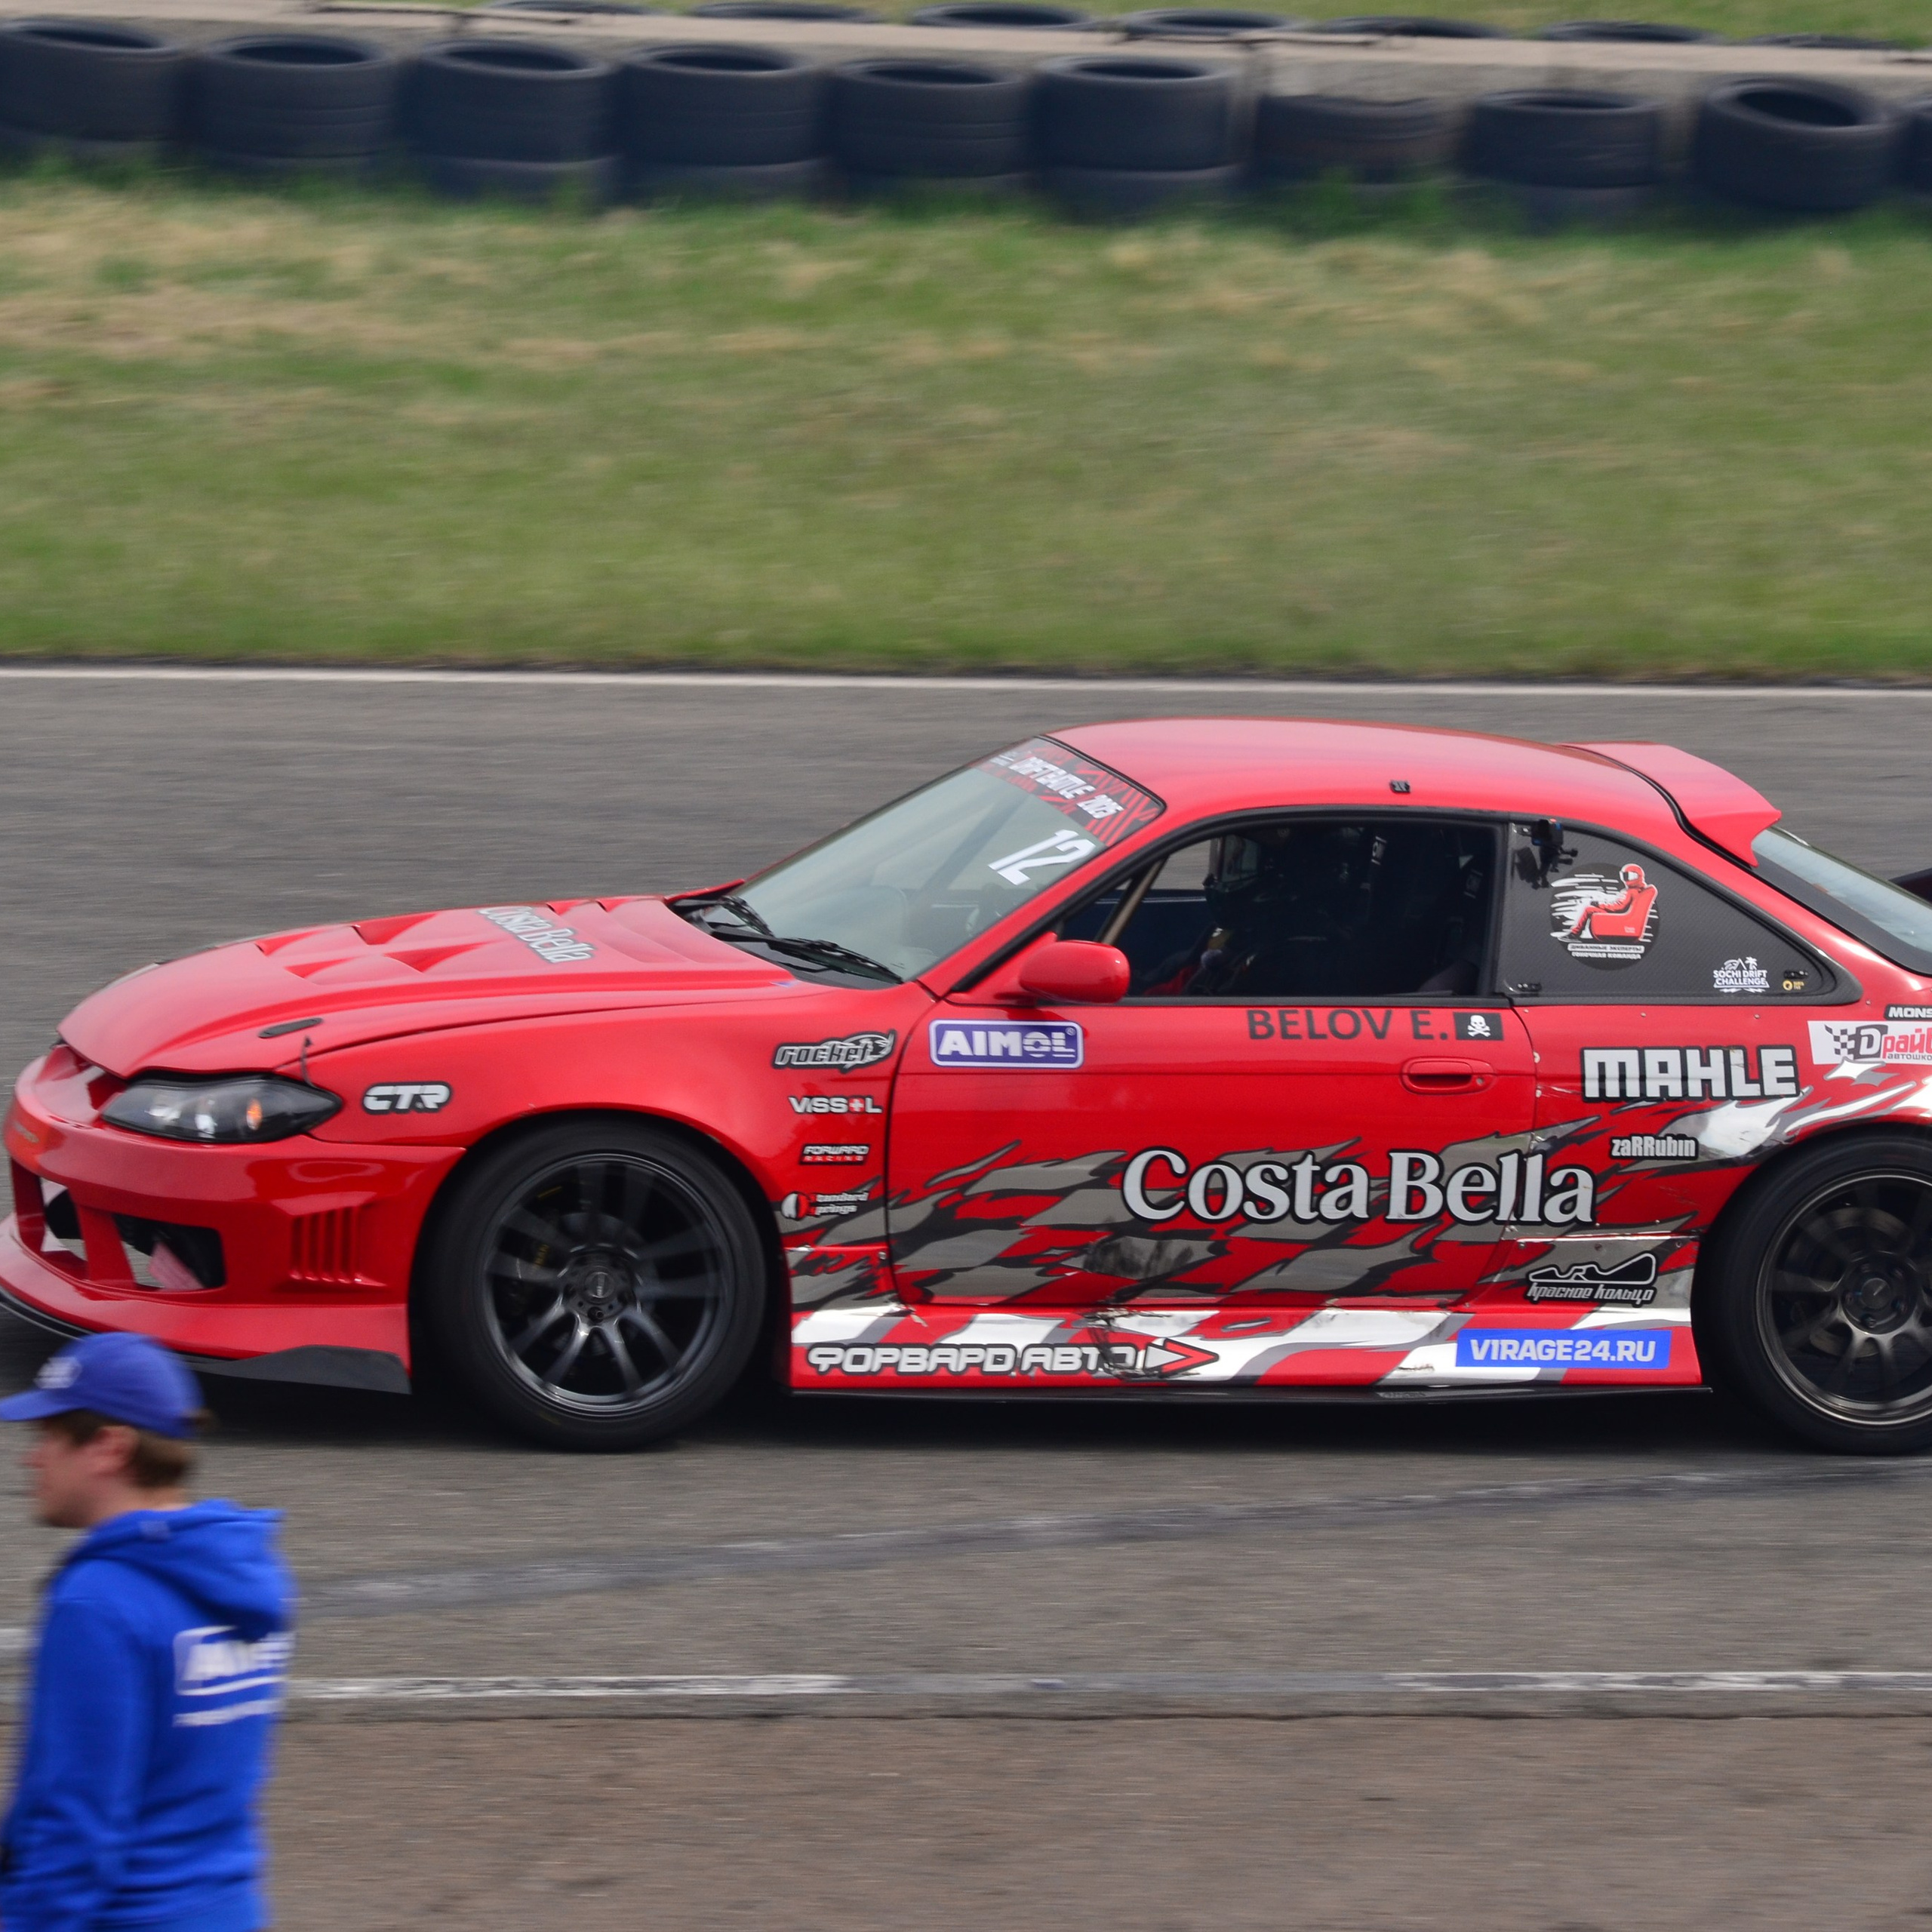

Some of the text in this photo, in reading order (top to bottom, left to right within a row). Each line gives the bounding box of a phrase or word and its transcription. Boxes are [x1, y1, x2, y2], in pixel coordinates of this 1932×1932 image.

[988, 829, 1096, 885] 12
[1713, 970, 1741, 978] SOCHI
[1247, 1009, 1448, 1040] BELOV E.
[938, 1030, 1075, 1058] AIMOL
[1583, 1048, 1797, 1097] MAHLE
[364, 1084, 451, 1110] CTR
[1124, 1149, 1593, 1223] Costa Bella
[1470, 1339, 1656, 1362] VIRAGE24.RU
